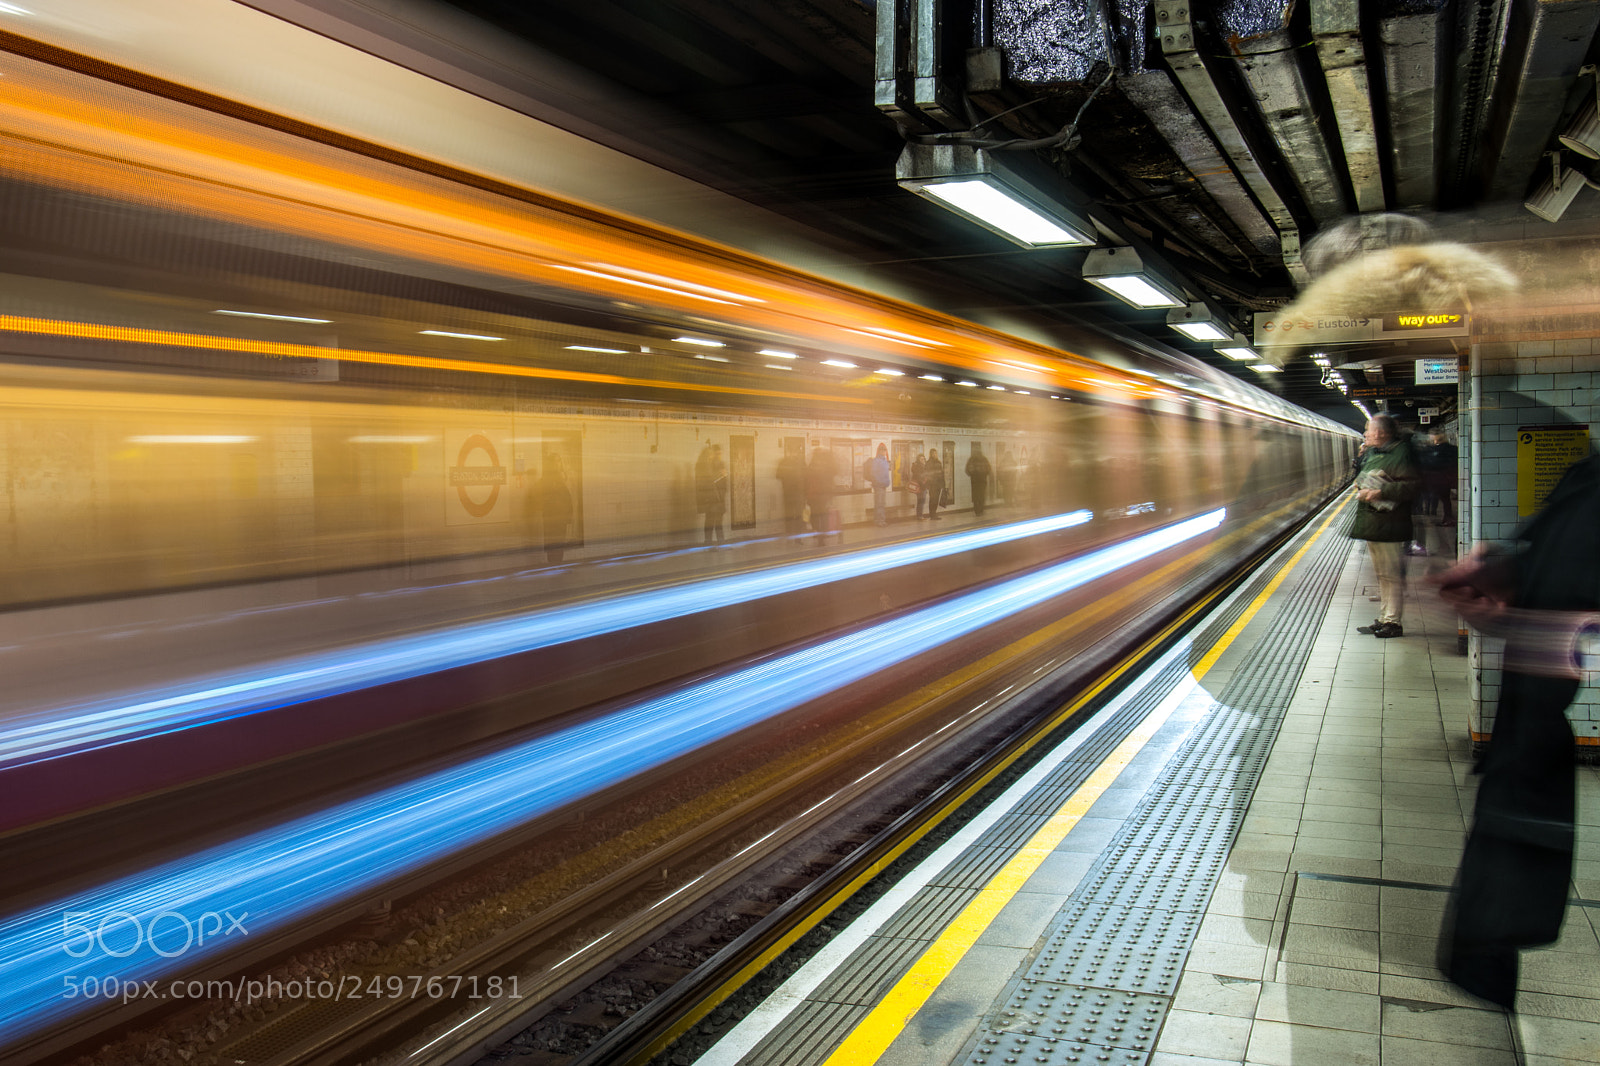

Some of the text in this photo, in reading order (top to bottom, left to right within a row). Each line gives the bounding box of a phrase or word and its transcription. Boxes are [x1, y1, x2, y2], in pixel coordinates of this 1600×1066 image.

[1317, 318, 1358, 329] Euston
[1399, 314, 1449, 327] way out
